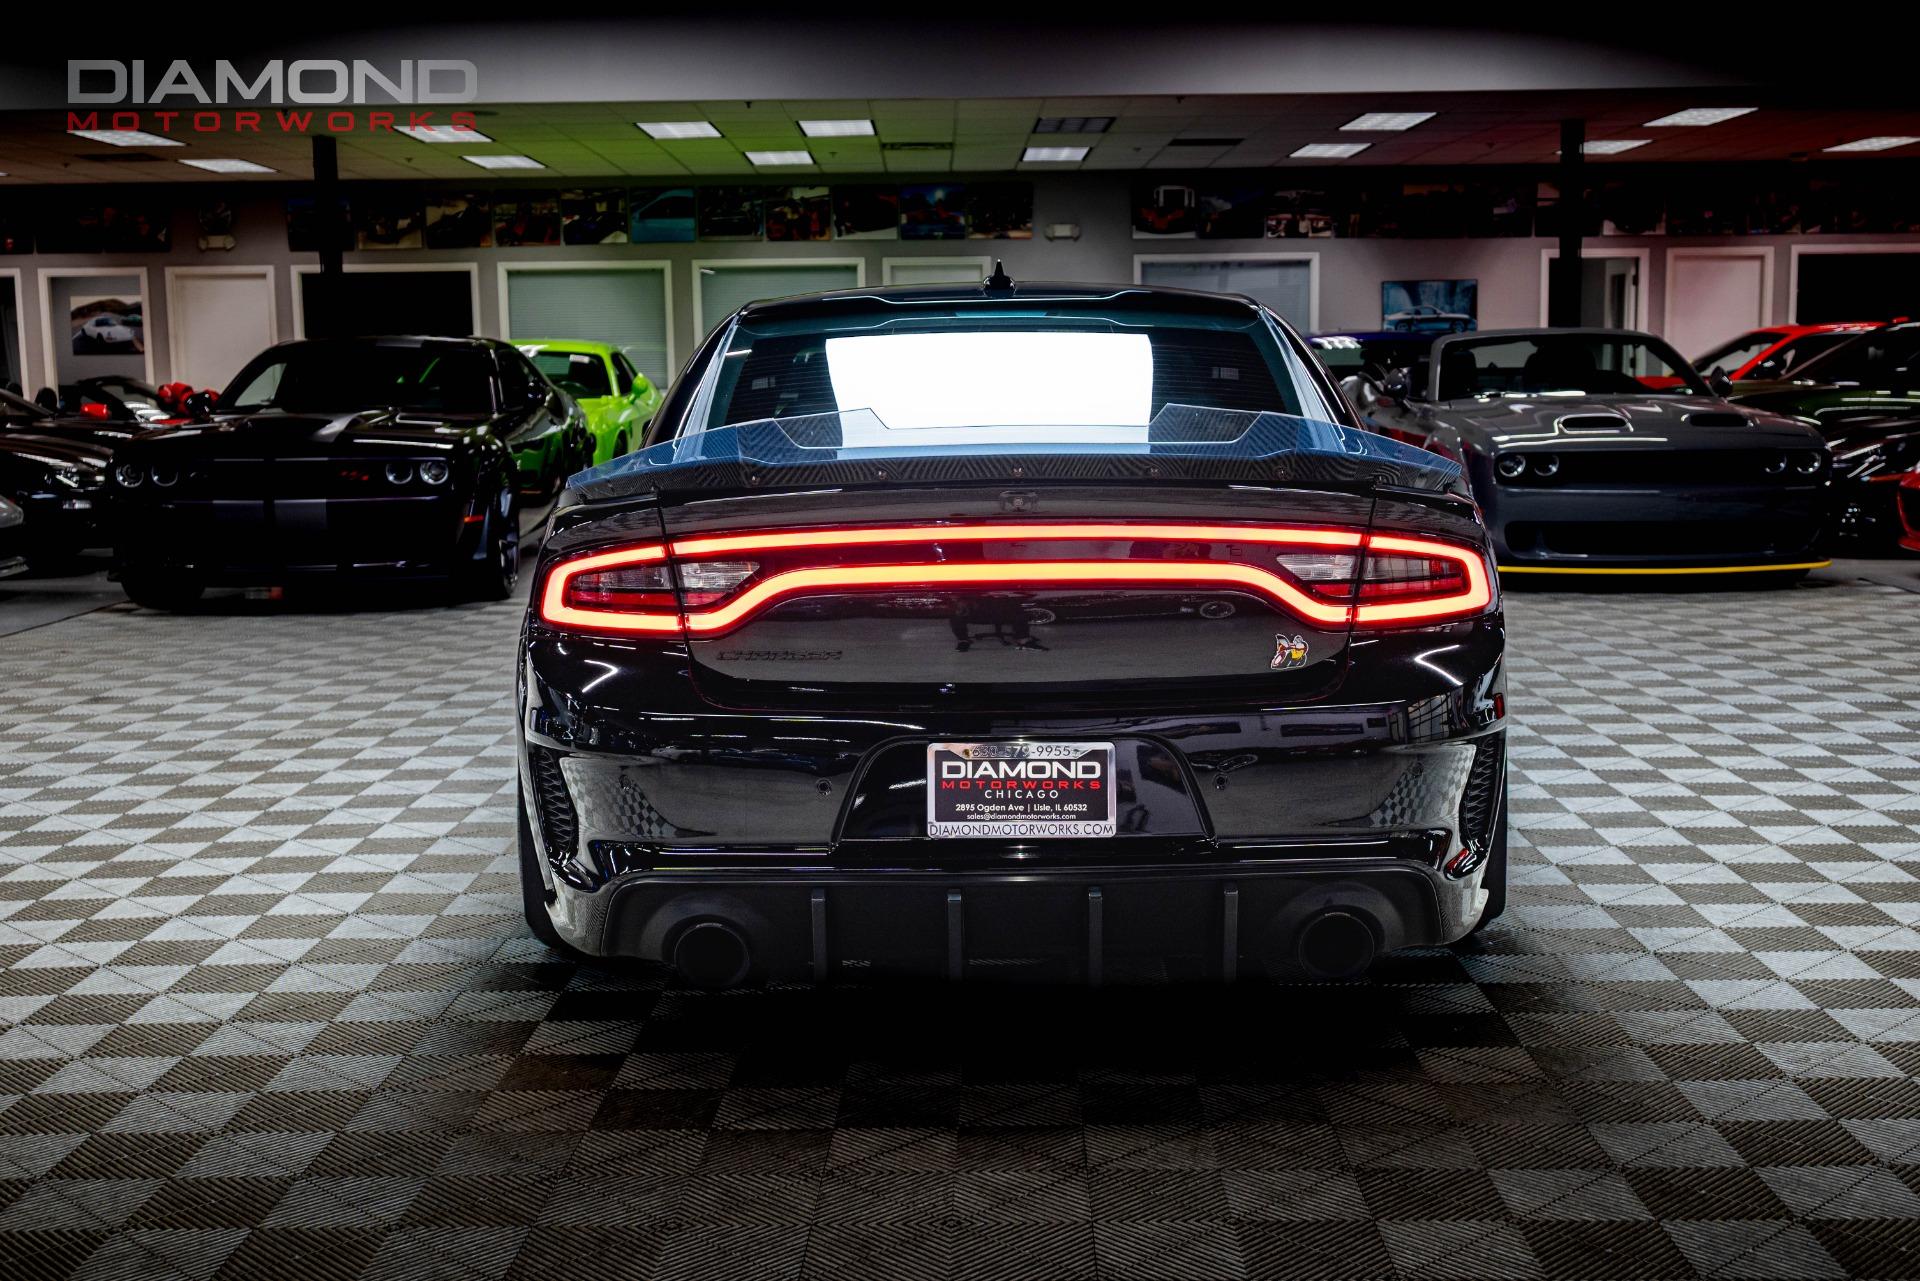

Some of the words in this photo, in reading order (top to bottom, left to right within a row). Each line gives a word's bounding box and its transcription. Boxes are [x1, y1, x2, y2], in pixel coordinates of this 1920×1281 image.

[942, 761, 1101, 779] DIAMOND
[942, 780, 1101, 789] MOTORWORKS
[984, 790, 1059, 799] CHICAGO
[977, 804, 1006, 813] Ogden
[1034, 804, 1053, 812] Lisle,
[929, 824, 1114, 836] DIAMONDMOTORWORKS.COM
